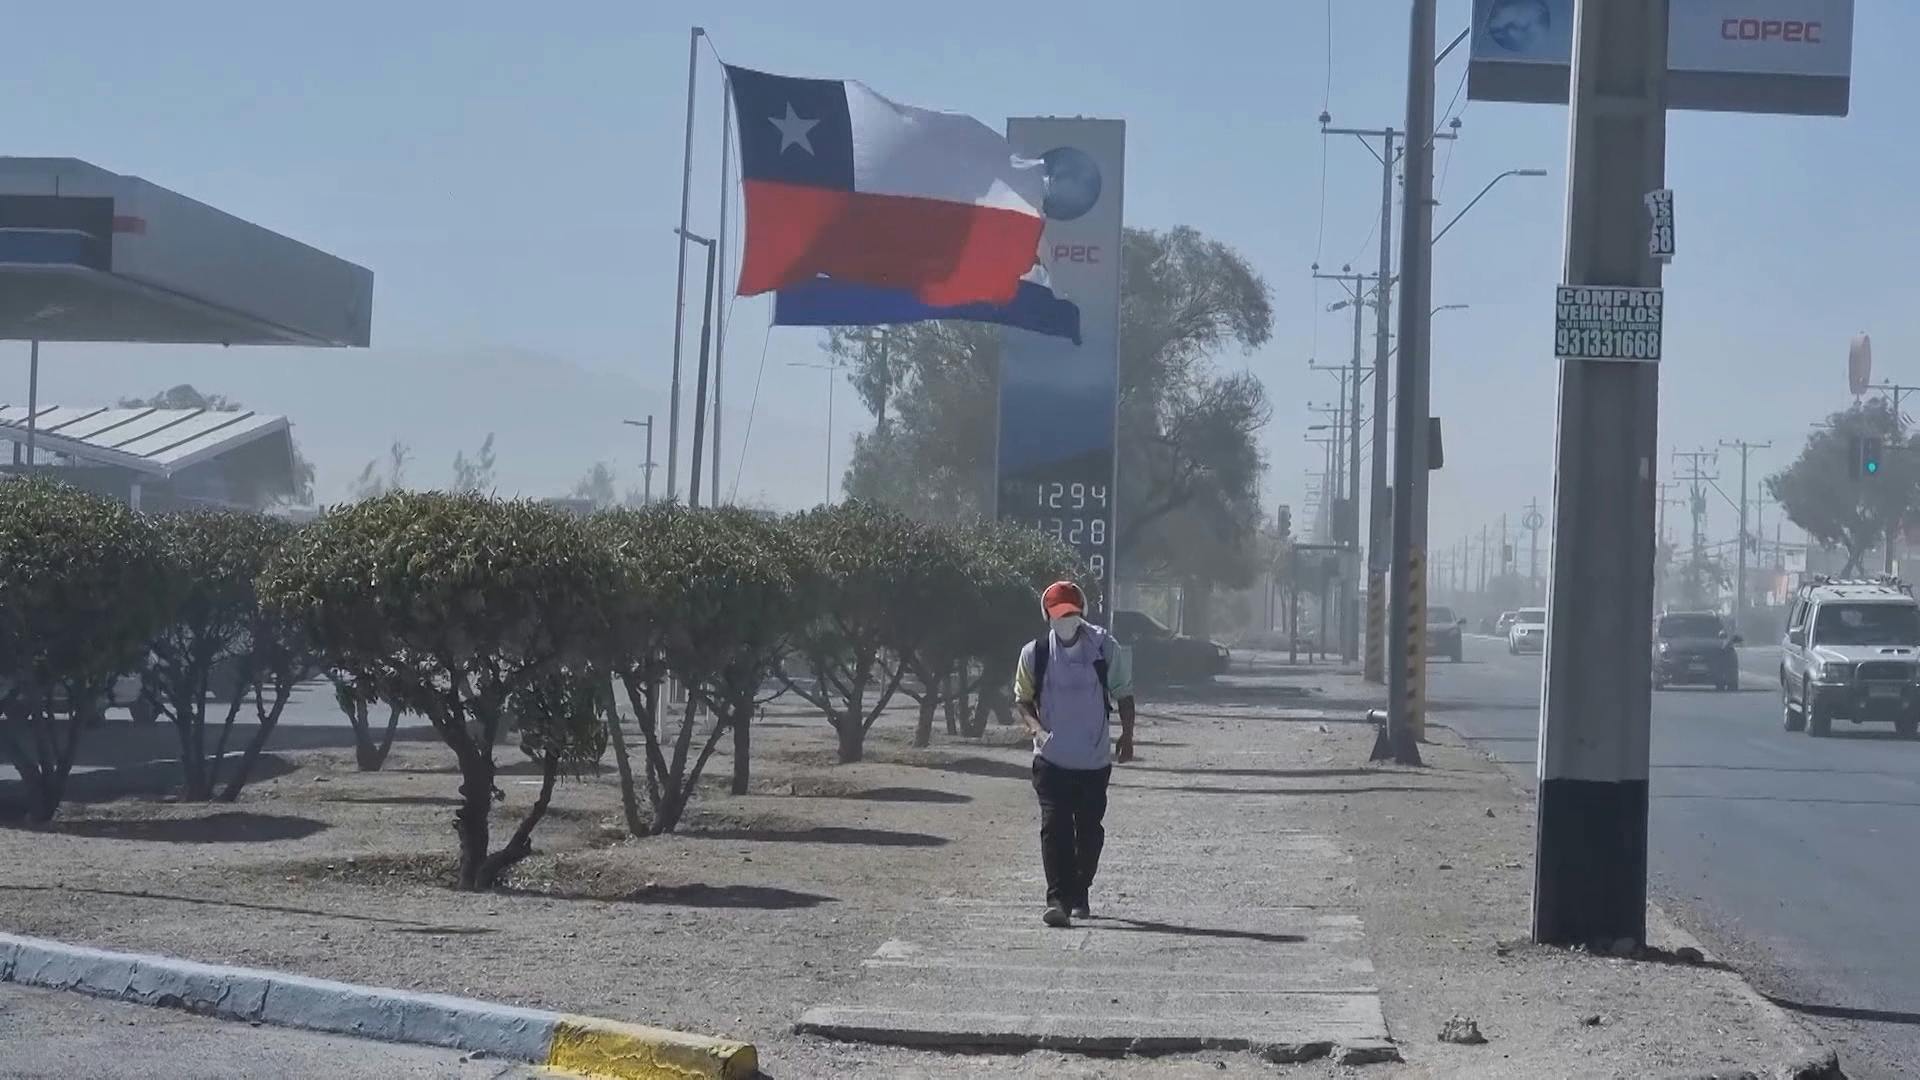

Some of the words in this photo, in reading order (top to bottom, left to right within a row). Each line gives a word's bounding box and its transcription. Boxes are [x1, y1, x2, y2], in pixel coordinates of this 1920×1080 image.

[1558, 288, 1661, 306] COMPRO
[1558, 305, 1660, 322] VEHICULOS
[1557, 329, 1659, 358] 931331668
[1038, 483, 1106, 508] 1294
